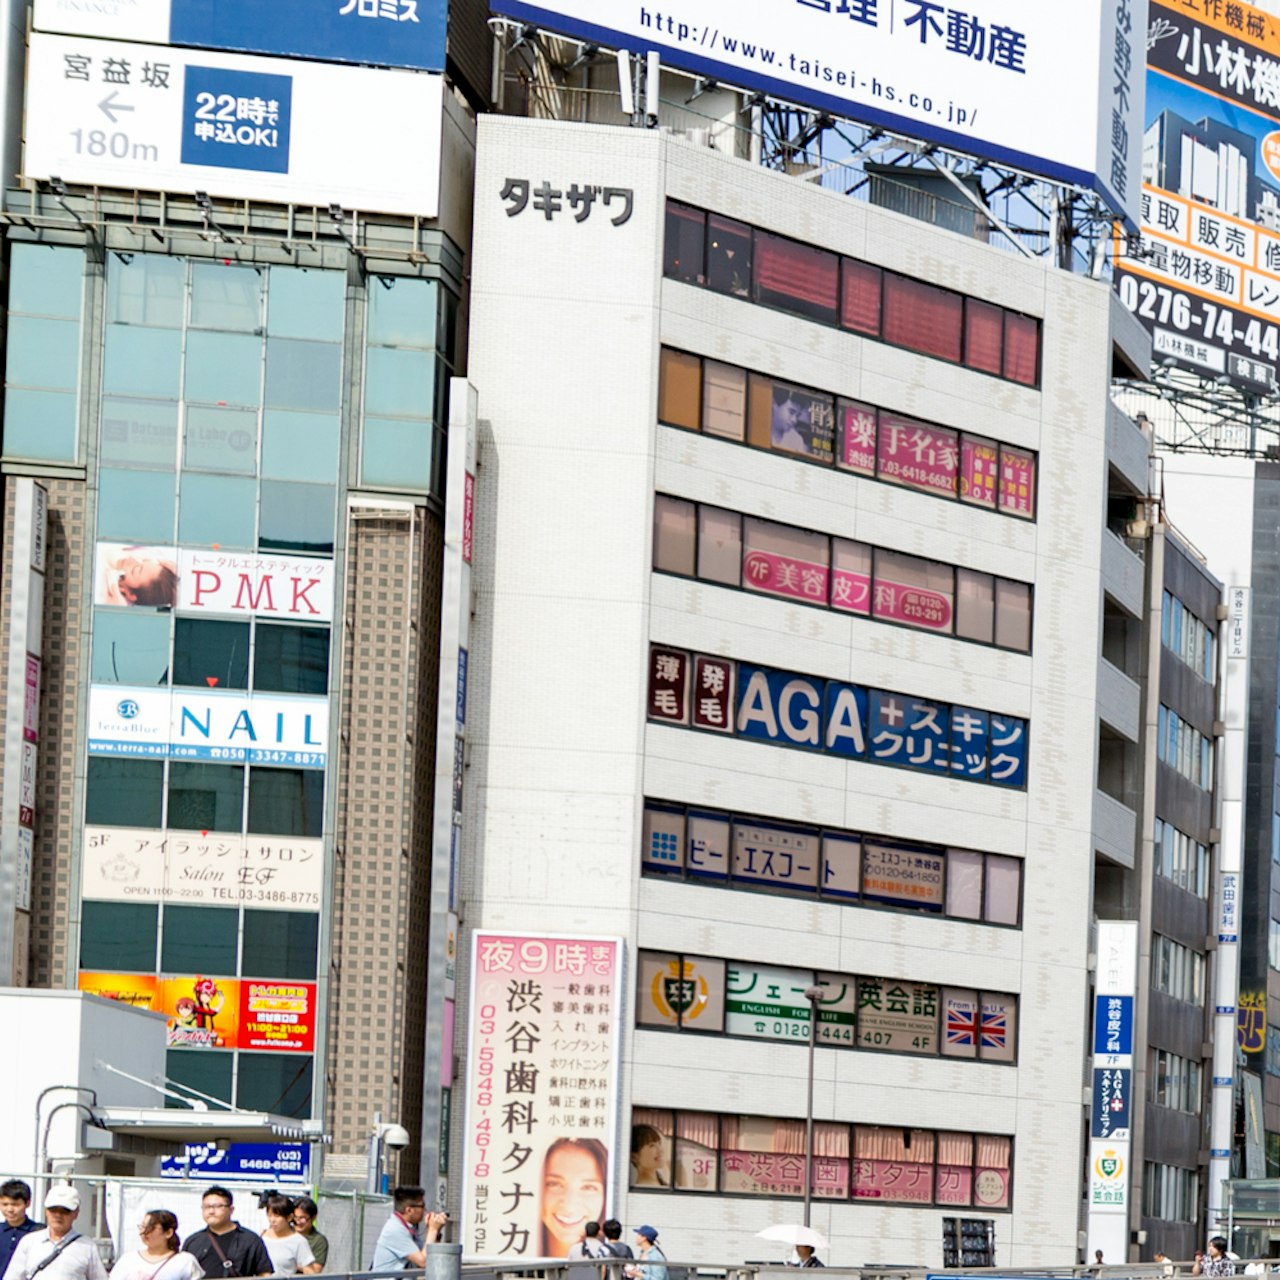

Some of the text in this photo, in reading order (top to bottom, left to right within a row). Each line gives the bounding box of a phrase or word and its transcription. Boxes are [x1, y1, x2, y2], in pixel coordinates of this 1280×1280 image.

[904, 0, 1028, 75] 不動産
[63, 53, 171, 89] 宮益坂
[640, 7, 979, 127] http://www.taisei-hs.co.jp/
[195, 92, 279, 125] 22時まで
[69, 128, 159, 162] 180m
[195, 121, 279, 148] 申込OK!
[499, 176, 635, 228] タキザワ
[1200, 215, 1247, 259] 販売
[749, 559, 769, 580] 7F
[189, 570, 322, 615] PMK
[775, 562, 897, 614] 美容皮フ科
[904, 604, 942, 622] 213-291
[655, 655, 680, 717] 薄毛
[700, 663, 726, 725] 発毛
[181, 705, 323, 746] NAIL
[737, 670, 866, 754] AGA
[910, 702, 1023, 748] スキン
[872, 730, 1020, 779] クリニック
[135, 838, 315, 864] アイラッシュサロン
[179, 863, 225, 884] Salon
[874, 863, 941, 884] 0120-64-1850
[1222, 875, 1237, 927] 武田歯科
[480, 940, 612, 976] 夜9時まで
[552, 1020, 610, 1035] 入れ歯
[741, 1003, 781, 1016] ENGLISH
[820, 1012, 839, 1022] LIFE
[1106, 997, 1122, 1053] 渋谷皮フ科
[550, 1039, 609, 1053] インプラント
[911, 1035, 931, 1050] 4F
[1106, 1054, 1120, 1066] 7F
[549, 1057, 610, 1072] ホワイトニング
[474, 1004, 497, 1178] 03-5948-4618
[1112, 1069, 1124, 1100] AGA
[498, 978, 545, 1256] 渋谷歯科タナカ
[547, 1114, 606, 1128] 小児歯科
[1100, 1069, 1112, 1138] スキンクリニック
[692, 1158, 716, 1177] 3F
[474, 1183, 490, 1253] 当ビル3F
